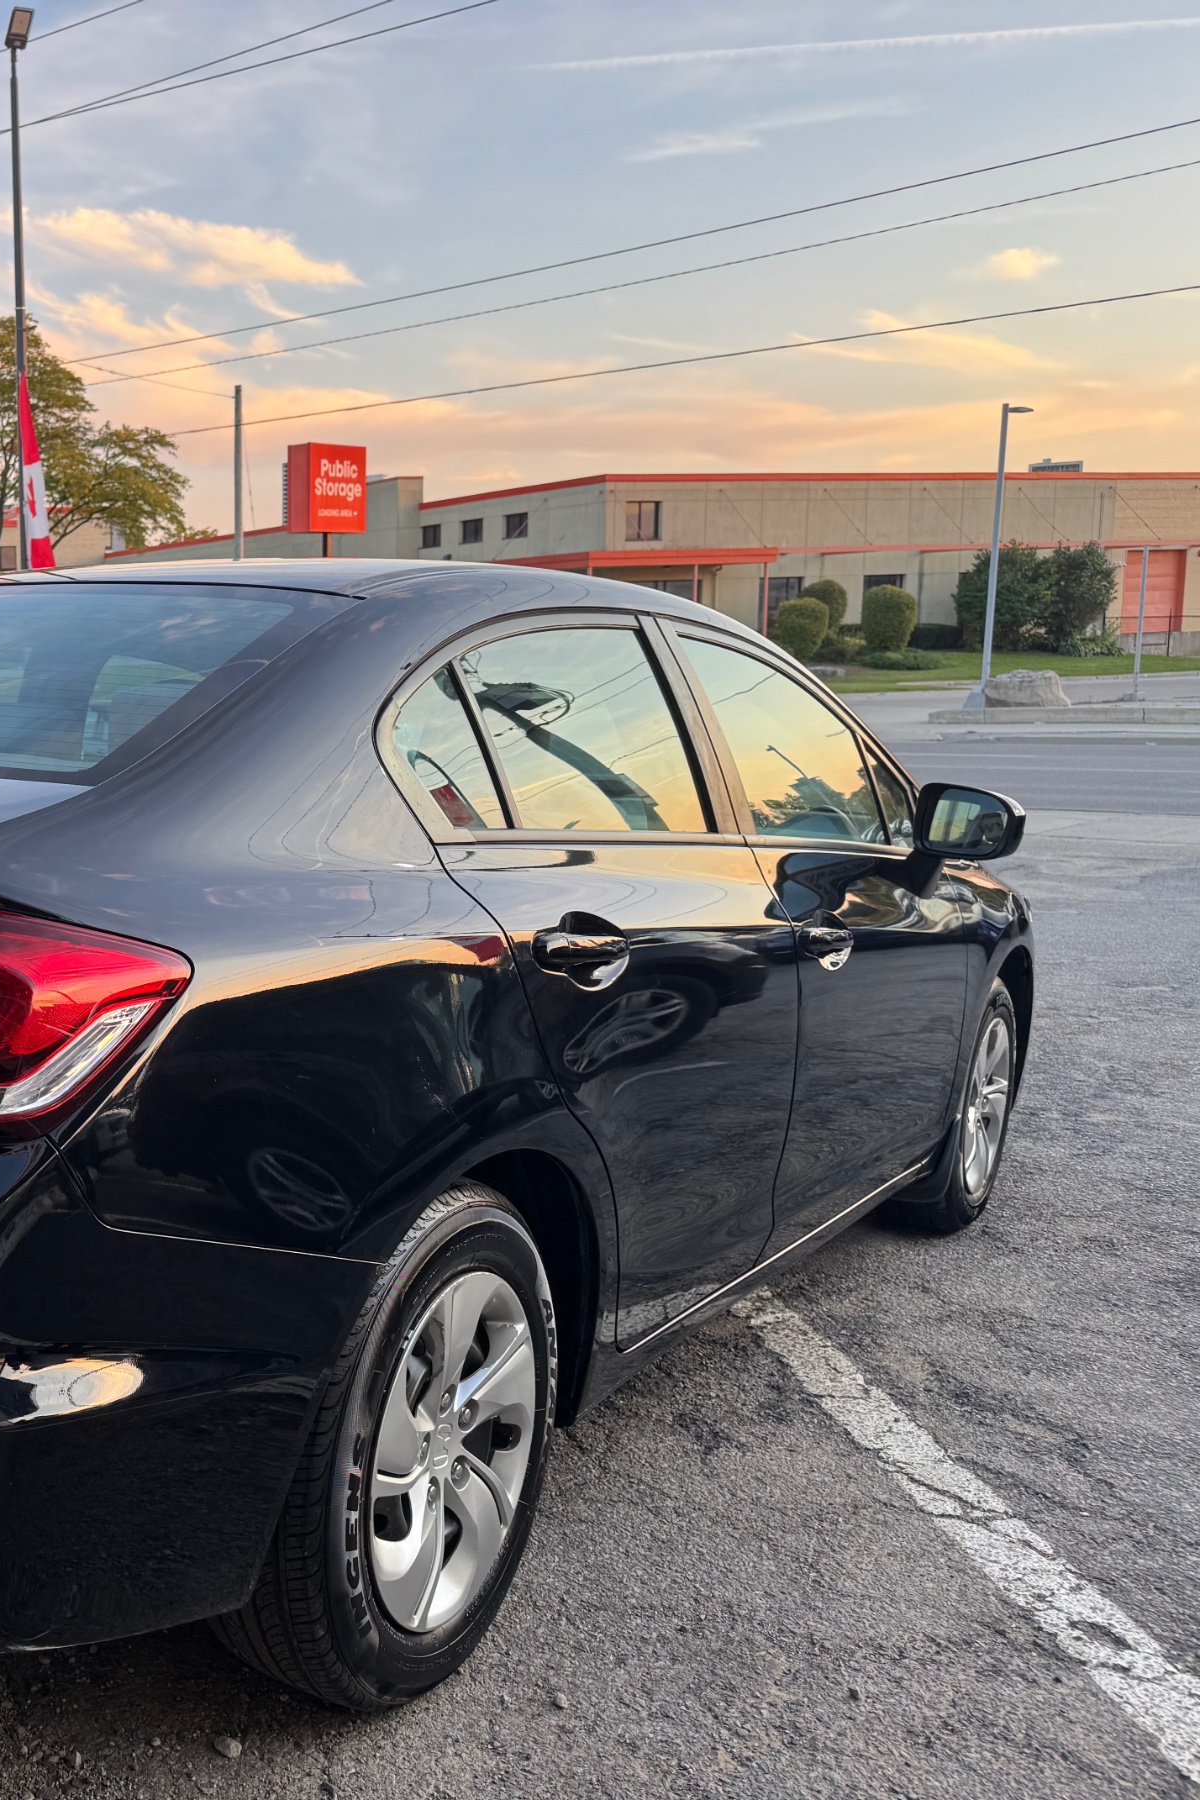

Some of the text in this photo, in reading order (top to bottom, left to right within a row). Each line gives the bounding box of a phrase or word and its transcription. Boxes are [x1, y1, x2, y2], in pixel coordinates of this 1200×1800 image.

[320, 459, 358, 478] Public
[314, 477, 362, 502] Storage
[345, 1431, 373, 1640] INGENS
